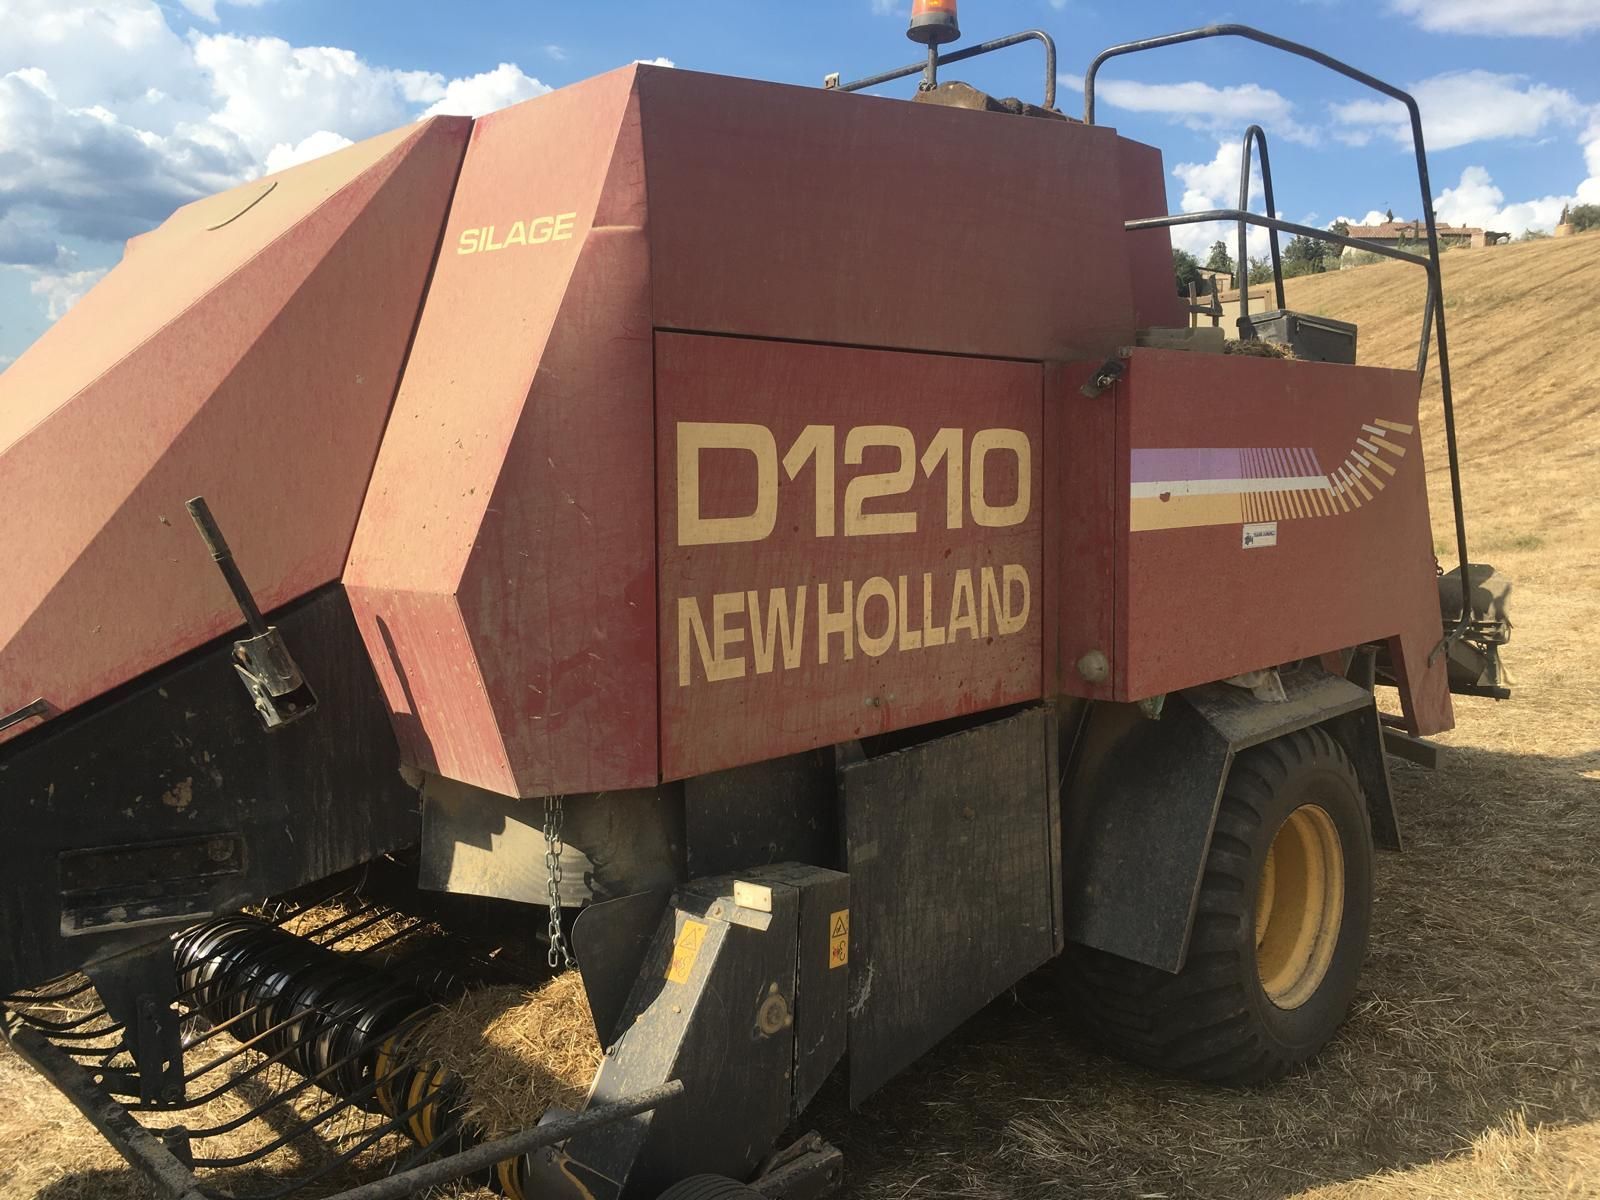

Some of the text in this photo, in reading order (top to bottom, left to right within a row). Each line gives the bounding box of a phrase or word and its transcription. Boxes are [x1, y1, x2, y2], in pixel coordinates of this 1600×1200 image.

[457, 212, 577, 255] SILAGE
[676, 421, 1032, 546] D1210
[677, 563, 1032, 687] NEW HOLLAND
